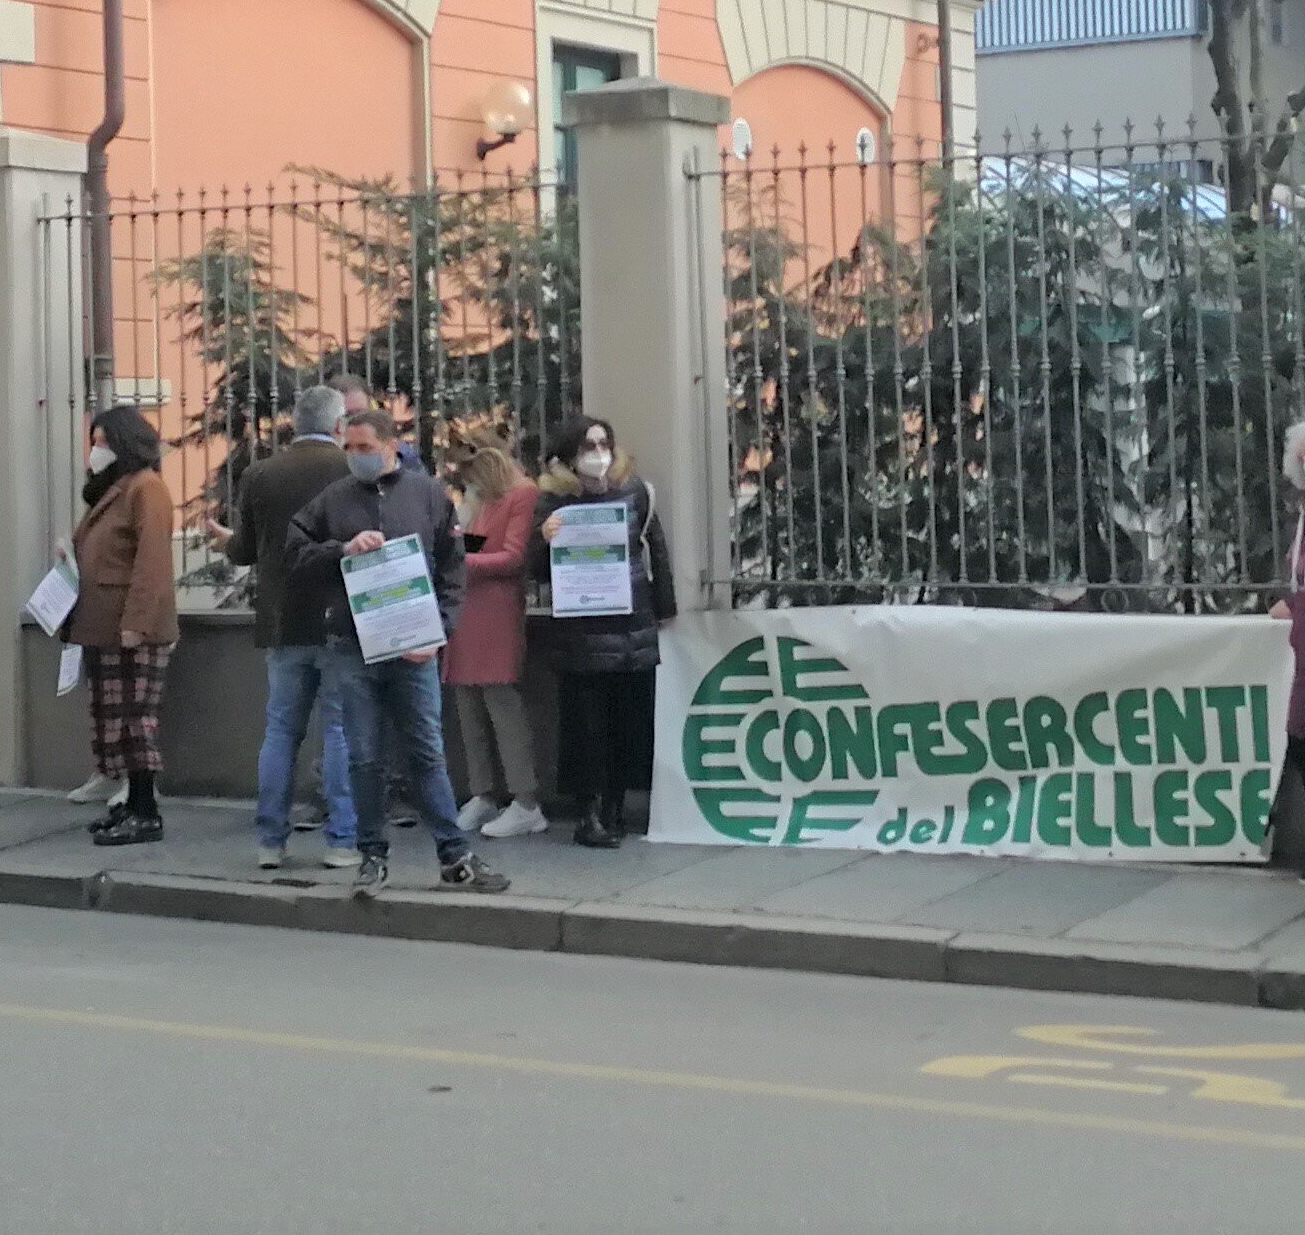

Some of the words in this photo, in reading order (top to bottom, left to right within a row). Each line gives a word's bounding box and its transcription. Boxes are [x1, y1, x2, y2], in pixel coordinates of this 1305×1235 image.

[746, 685, 1270, 782] CONFESERCENTI
[876, 805, 954, 845] del
[961, 769, 1271, 847] BIELLESE
